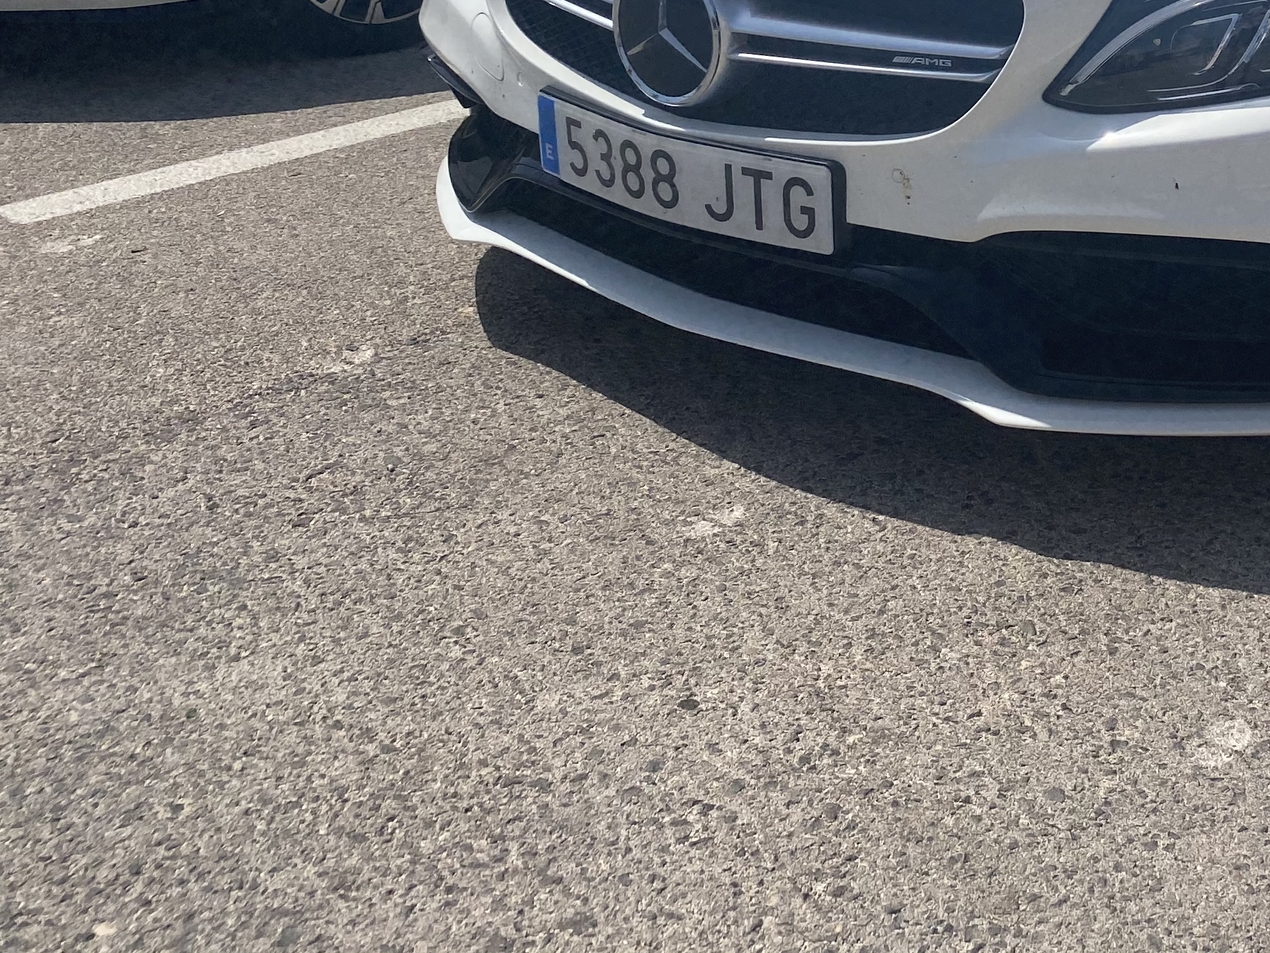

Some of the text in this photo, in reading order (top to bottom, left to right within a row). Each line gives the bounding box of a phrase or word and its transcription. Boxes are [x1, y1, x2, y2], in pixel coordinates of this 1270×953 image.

[911, 56, 952, 67] AMG
[545, 143, 555, 161] E
[565, 116, 816, 239] 5388 JTG
